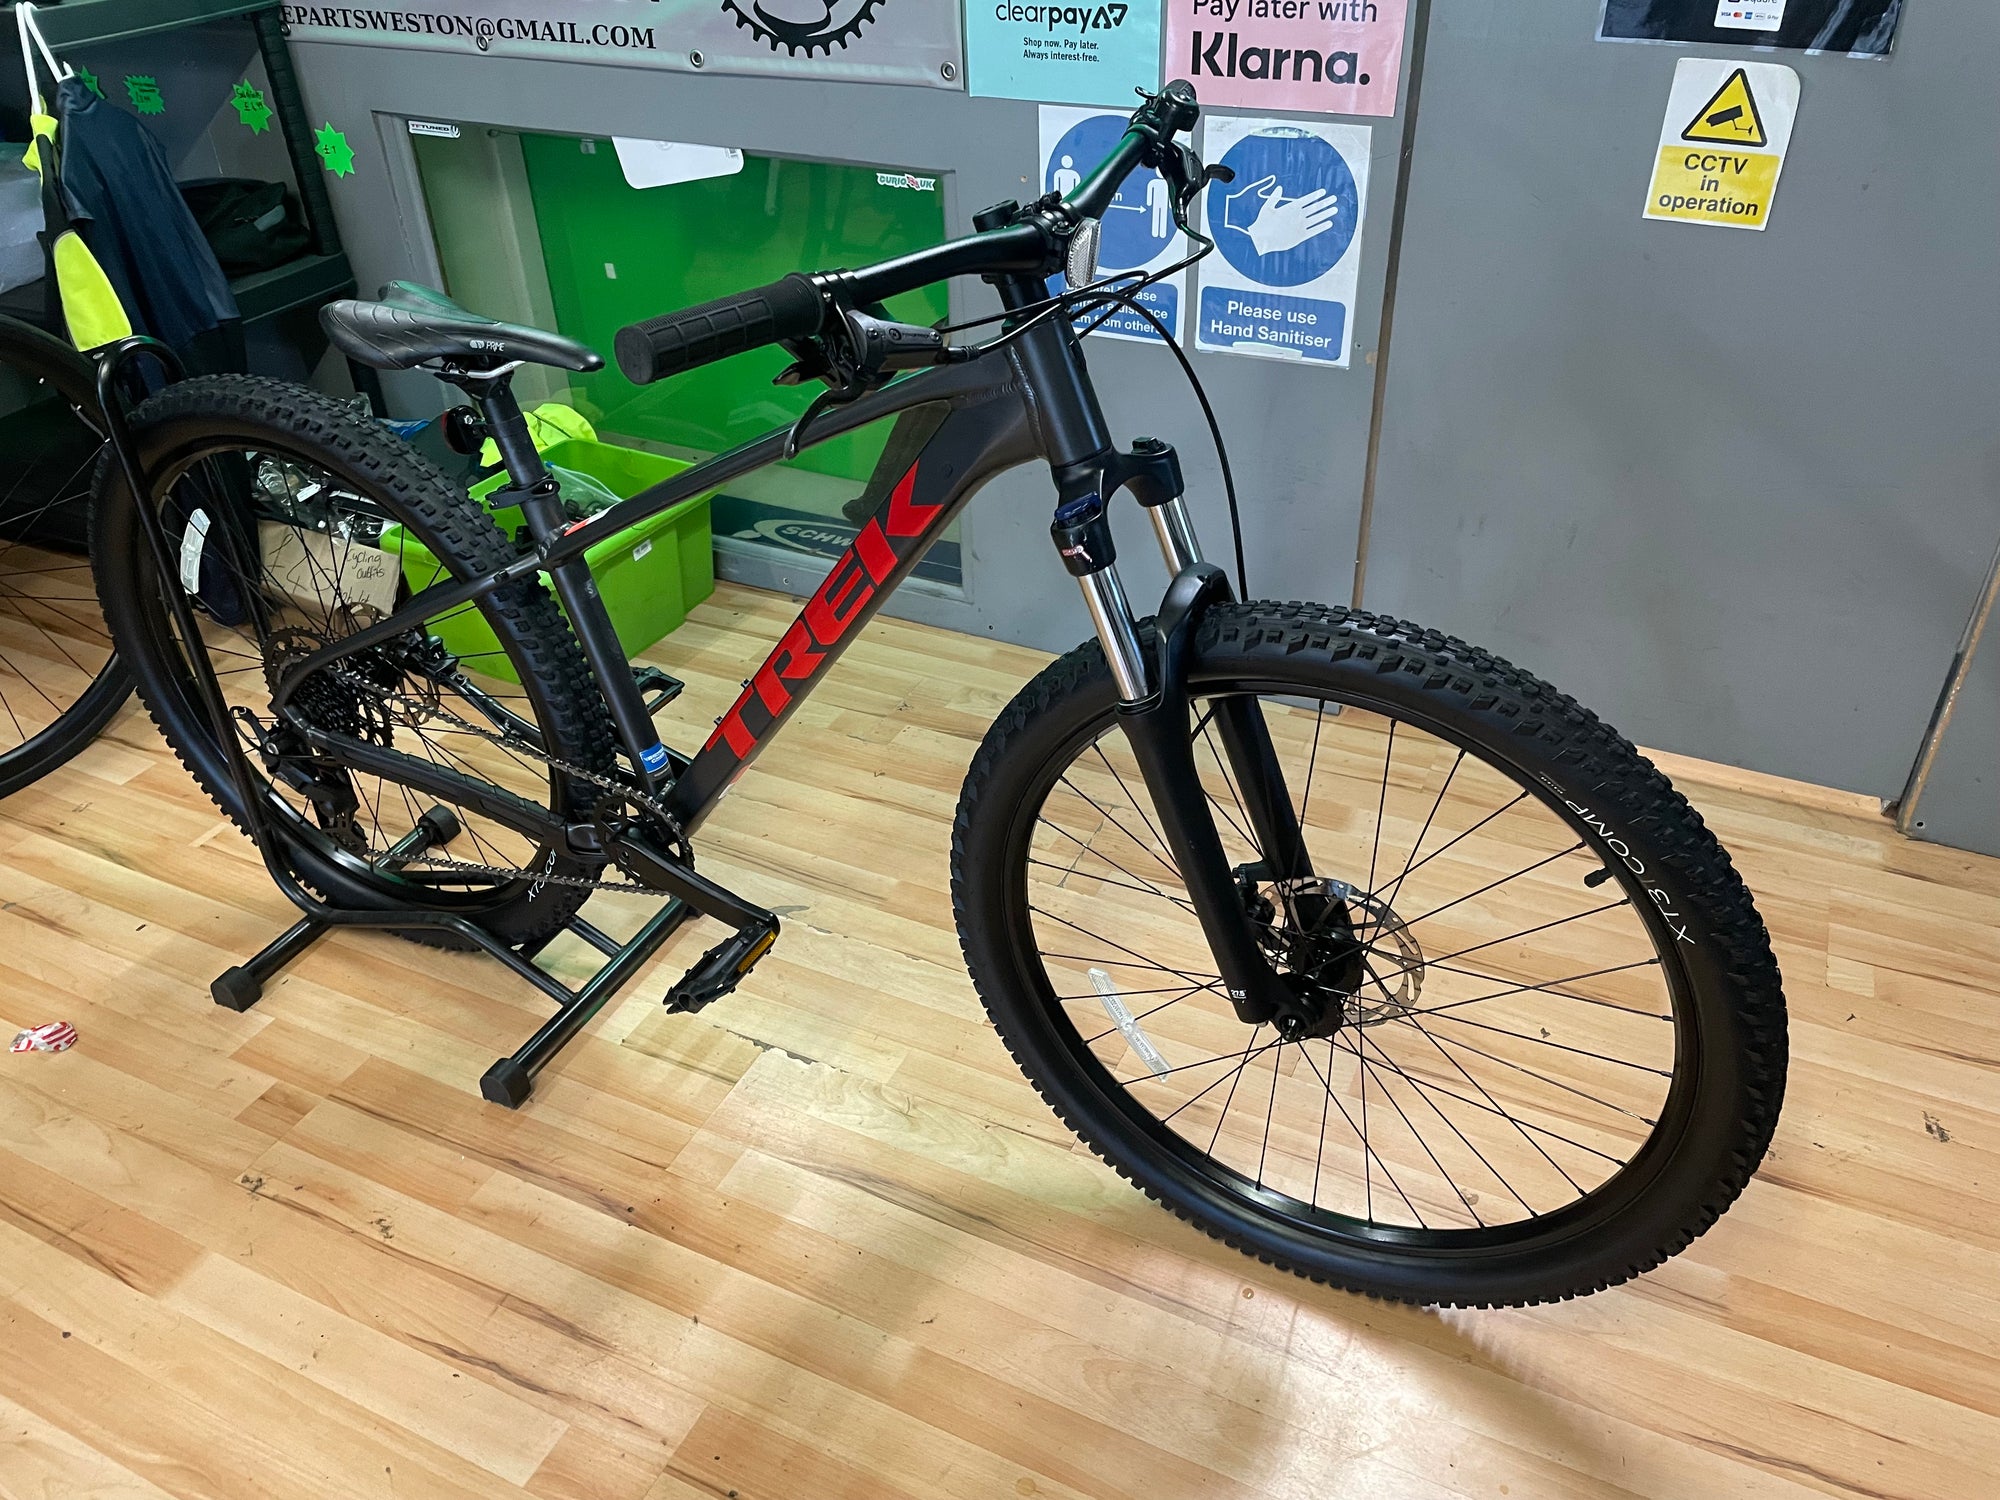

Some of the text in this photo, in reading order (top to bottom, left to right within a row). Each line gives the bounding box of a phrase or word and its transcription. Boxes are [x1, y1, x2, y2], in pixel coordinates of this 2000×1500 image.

[995, 0, 1092, 34] clearpay
[1192, 0, 1378, 22] Pay later with
[282, 5, 657, 49] EPARTSWESTON@GMAIL.COM
[1023, 37, 1099, 50] Shop now. Pay later.
[1023, 49, 1100, 62] Always interest-free.
[1191, 30, 1371, 86] Klarna.
[1684, 153, 1749, 175] CCTV
[1700, 175, 1720, 192] in
[1659, 194, 1759, 216] operation
[1227, 300, 1318, 325] Please use
[1210, 319, 1332, 349] Hand Sanitiser
[781, 525, 855, 548] SCHW
[705, 458, 945, 761] TREK
[1565, 799, 1646, 875] COMP
